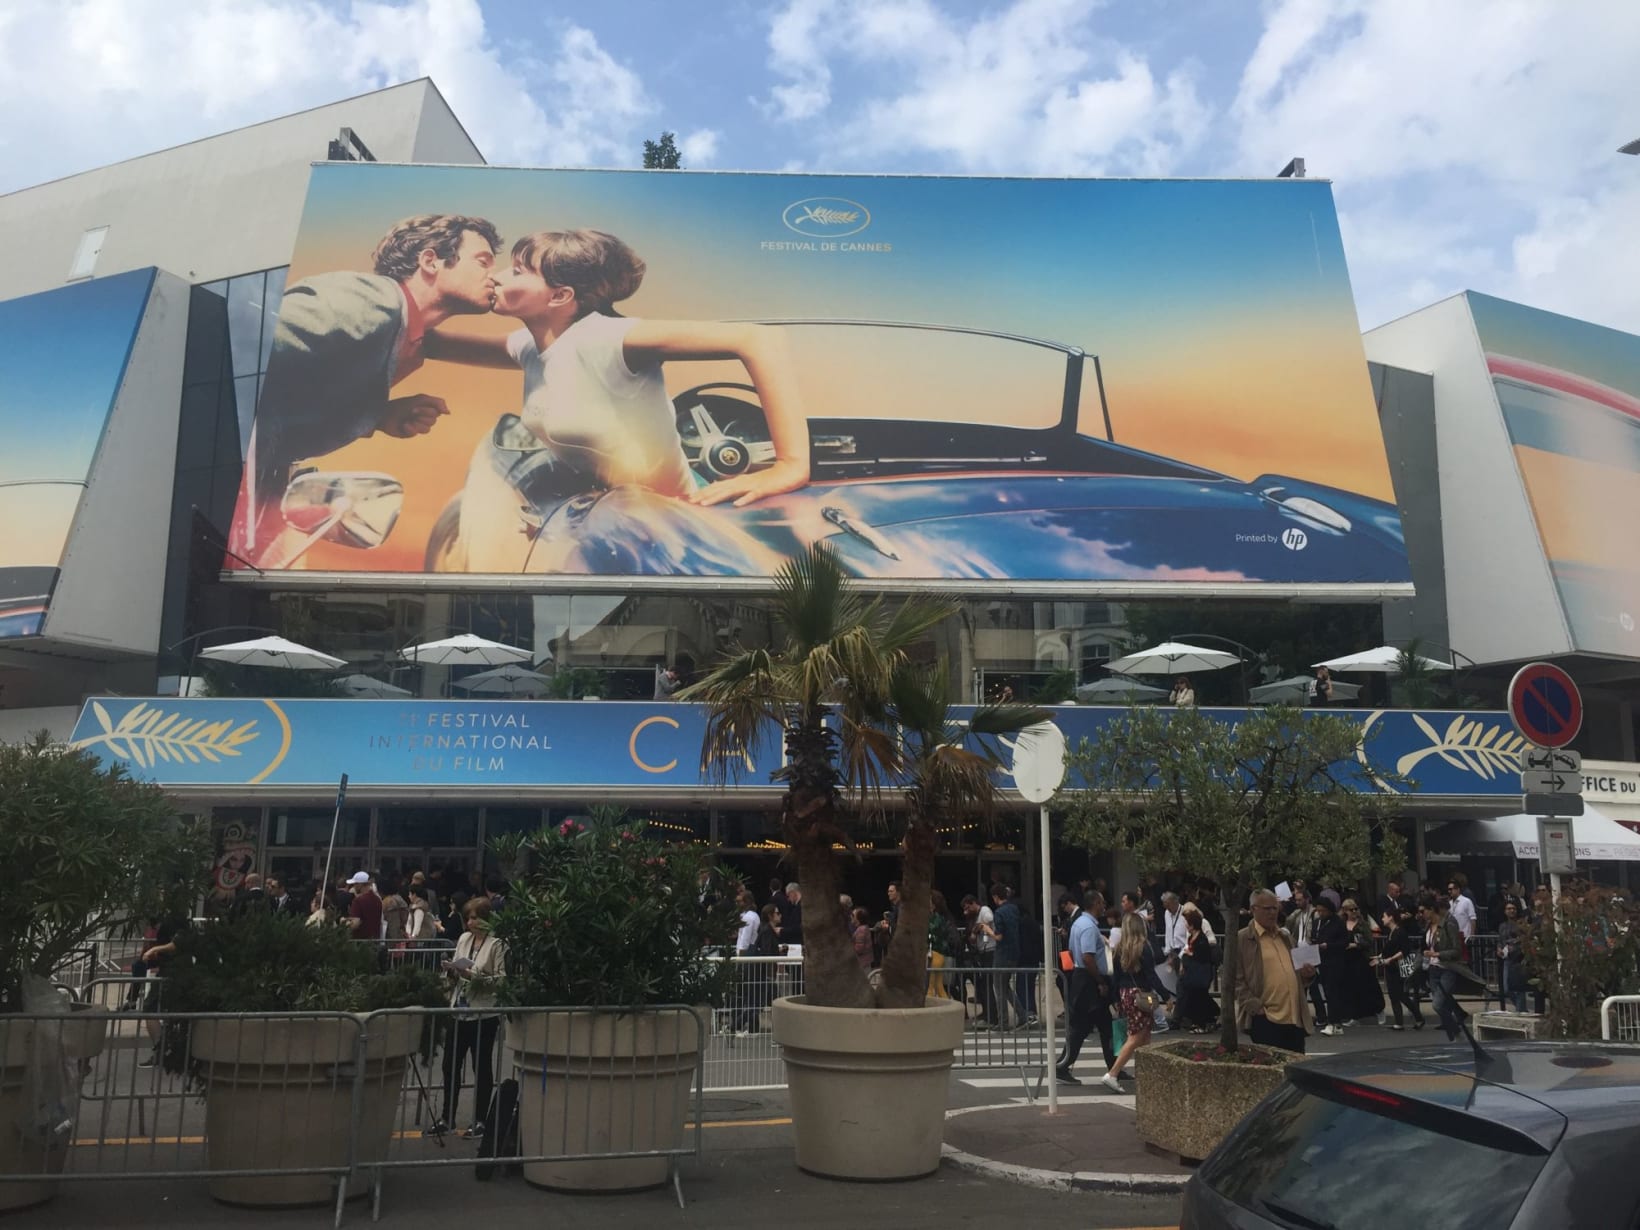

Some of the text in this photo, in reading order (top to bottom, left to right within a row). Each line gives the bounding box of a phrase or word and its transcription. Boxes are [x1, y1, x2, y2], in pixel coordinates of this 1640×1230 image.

[760, 241, 892, 252] FESTIVAL DE CANNES
[1235, 534, 1266, 543] Printed
[1267, 534, 1278, 544] by
[428, 713, 530, 728] FESTIVAL
[369, 734, 552, 750] INTERNATIONAL
[453, 757, 504, 771] FILM
[1620, 782, 1636, 793] DU
